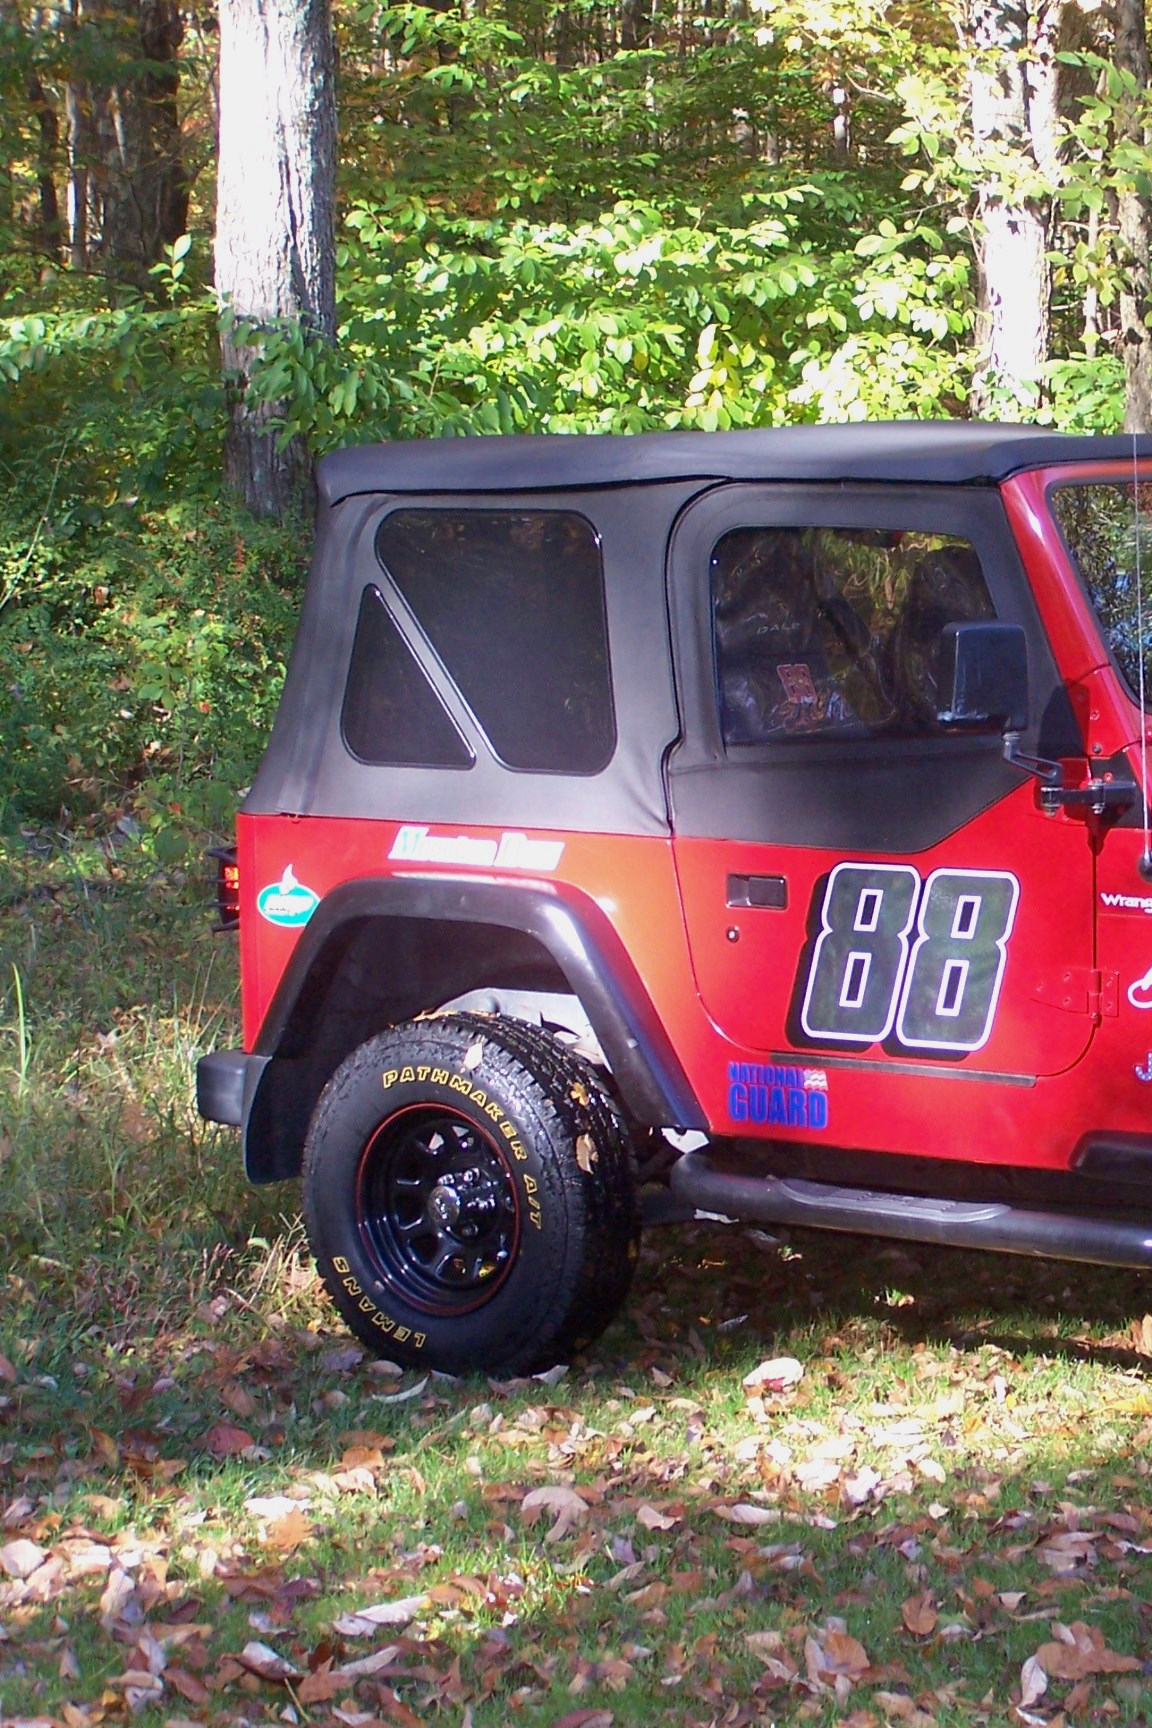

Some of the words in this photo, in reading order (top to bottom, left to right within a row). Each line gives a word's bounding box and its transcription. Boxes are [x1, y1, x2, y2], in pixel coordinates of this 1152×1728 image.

[790, 861, 1020, 1058] 88
[382, 1065, 527, 1162] PATHMAKER
[728, 1061, 804, 1088] NATIONAL
[728, 1082, 829, 1130] GUARD
[331, 1255, 426, 1348] LEMANS
